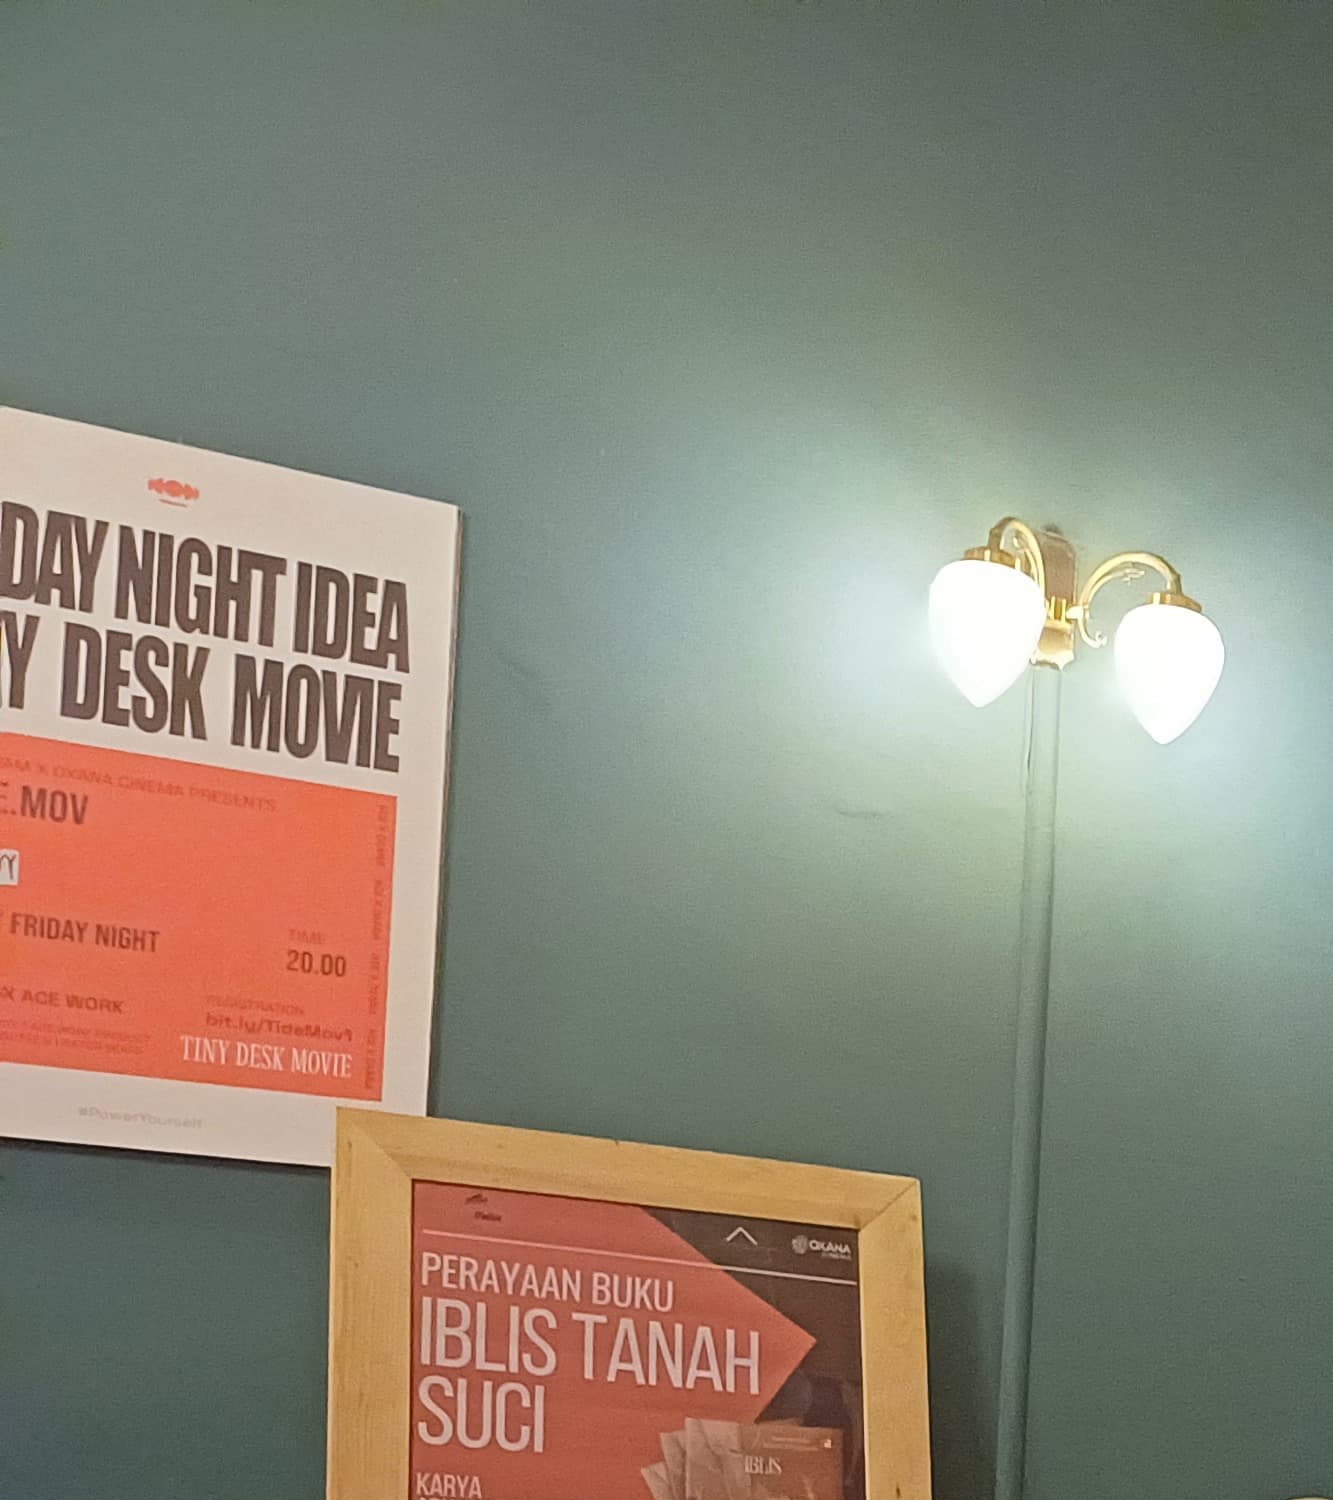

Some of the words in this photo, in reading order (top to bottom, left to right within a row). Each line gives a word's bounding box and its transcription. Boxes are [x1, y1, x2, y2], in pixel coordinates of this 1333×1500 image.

[114, 525, 287, 647] NIGHT
[293, 561, 410, 673] IDEA
[60, 622, 210, 741] DESK
[230, 654, 402, 773] MOVIE
[10, 912, 88, 944] FRIDAY
[94, 924, 161, 953] NIGHT
[287, 950, 347, 977] 20.00
[65, 994, 124, 1014] WORK
[181, 1034, 230, 1065] TINY
[236, 1041, 285, 1071] DESK
[291, 1047, 352, 1078] MOVIE
[422, 1252, 581, 1302] PERAYAAN
[592, 1272, 674, 1312] BUKU
[420, 1296, 557, 1376] IBLIS
[572, 1312, 760, 1395] TANAH
[417, 1375, 545, 1453] SUCI
[416, 1472, 482, 1499] KARYA
[745, 1455, 782, 1474] IBLIS
